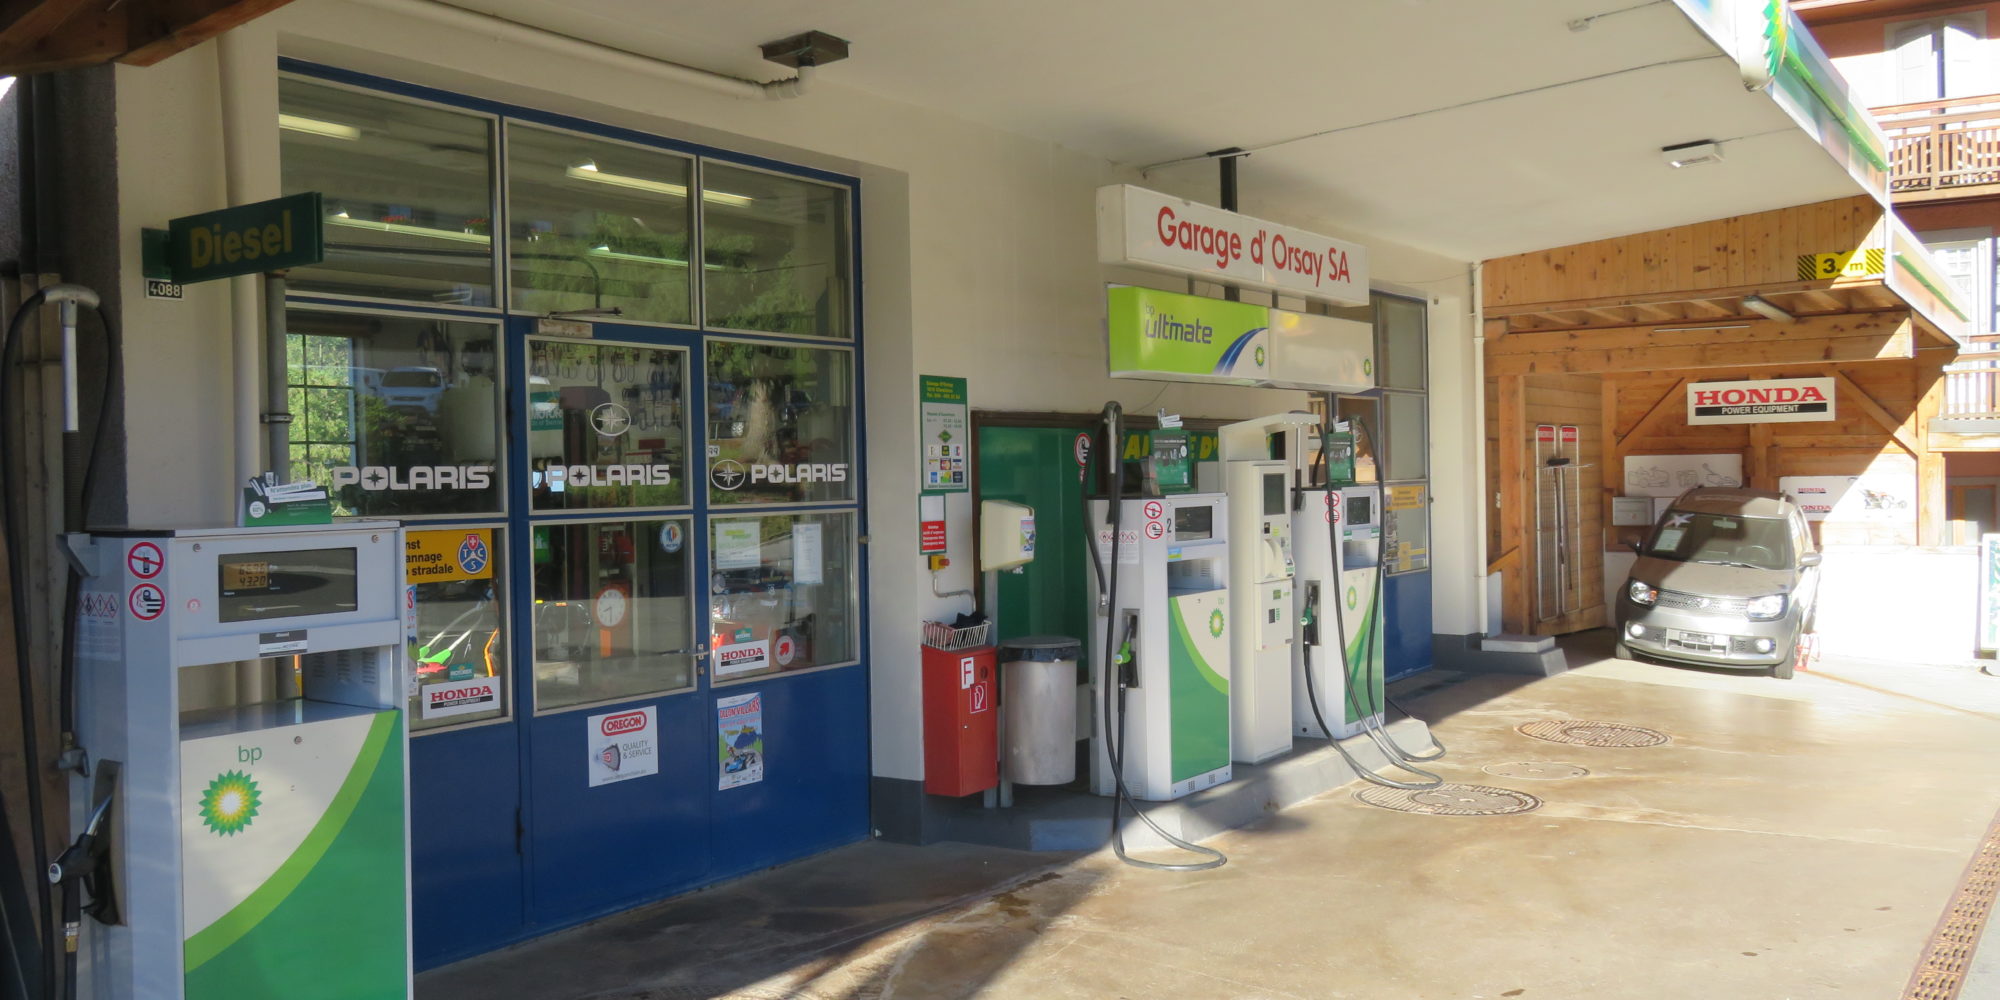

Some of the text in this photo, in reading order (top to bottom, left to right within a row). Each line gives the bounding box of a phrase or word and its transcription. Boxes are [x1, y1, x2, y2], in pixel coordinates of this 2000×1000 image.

[190, 209, 293, 269] Diesel
[1158, 206, 1241, 269] Garage
[1272, 234, 1323, 287] Orsay
[1329, 247, 1350, 284] SA
[150, 283, 181, 297] 4088
[1145, 313, 1213, 344] ultimate
[1695, 387, 1827, 405] HONDA
[1722, 404, 1799, 415] POWER EQUIPMENT
[333, 465, 490, 492] POLARIS
[546, 464, 671, 487] POLARIS
[751, 463, 846, 484] POLARIS
[1167, 518, 1172, 533] 2
[412, 563, 453, 576] stradale
[721, 647, 764, 661] HONDA
[964, 661, 971, 685] F
[431, 685, 493, 702] HONDA
[459, 697, 480, 705] EQUIPMENT
[607, 717, 641, 731] OREGON
[623, 740, 648, 751] QUALITY
[629, 747, 652, 758] SERVICE
[238, 745, 262, 765] bp
